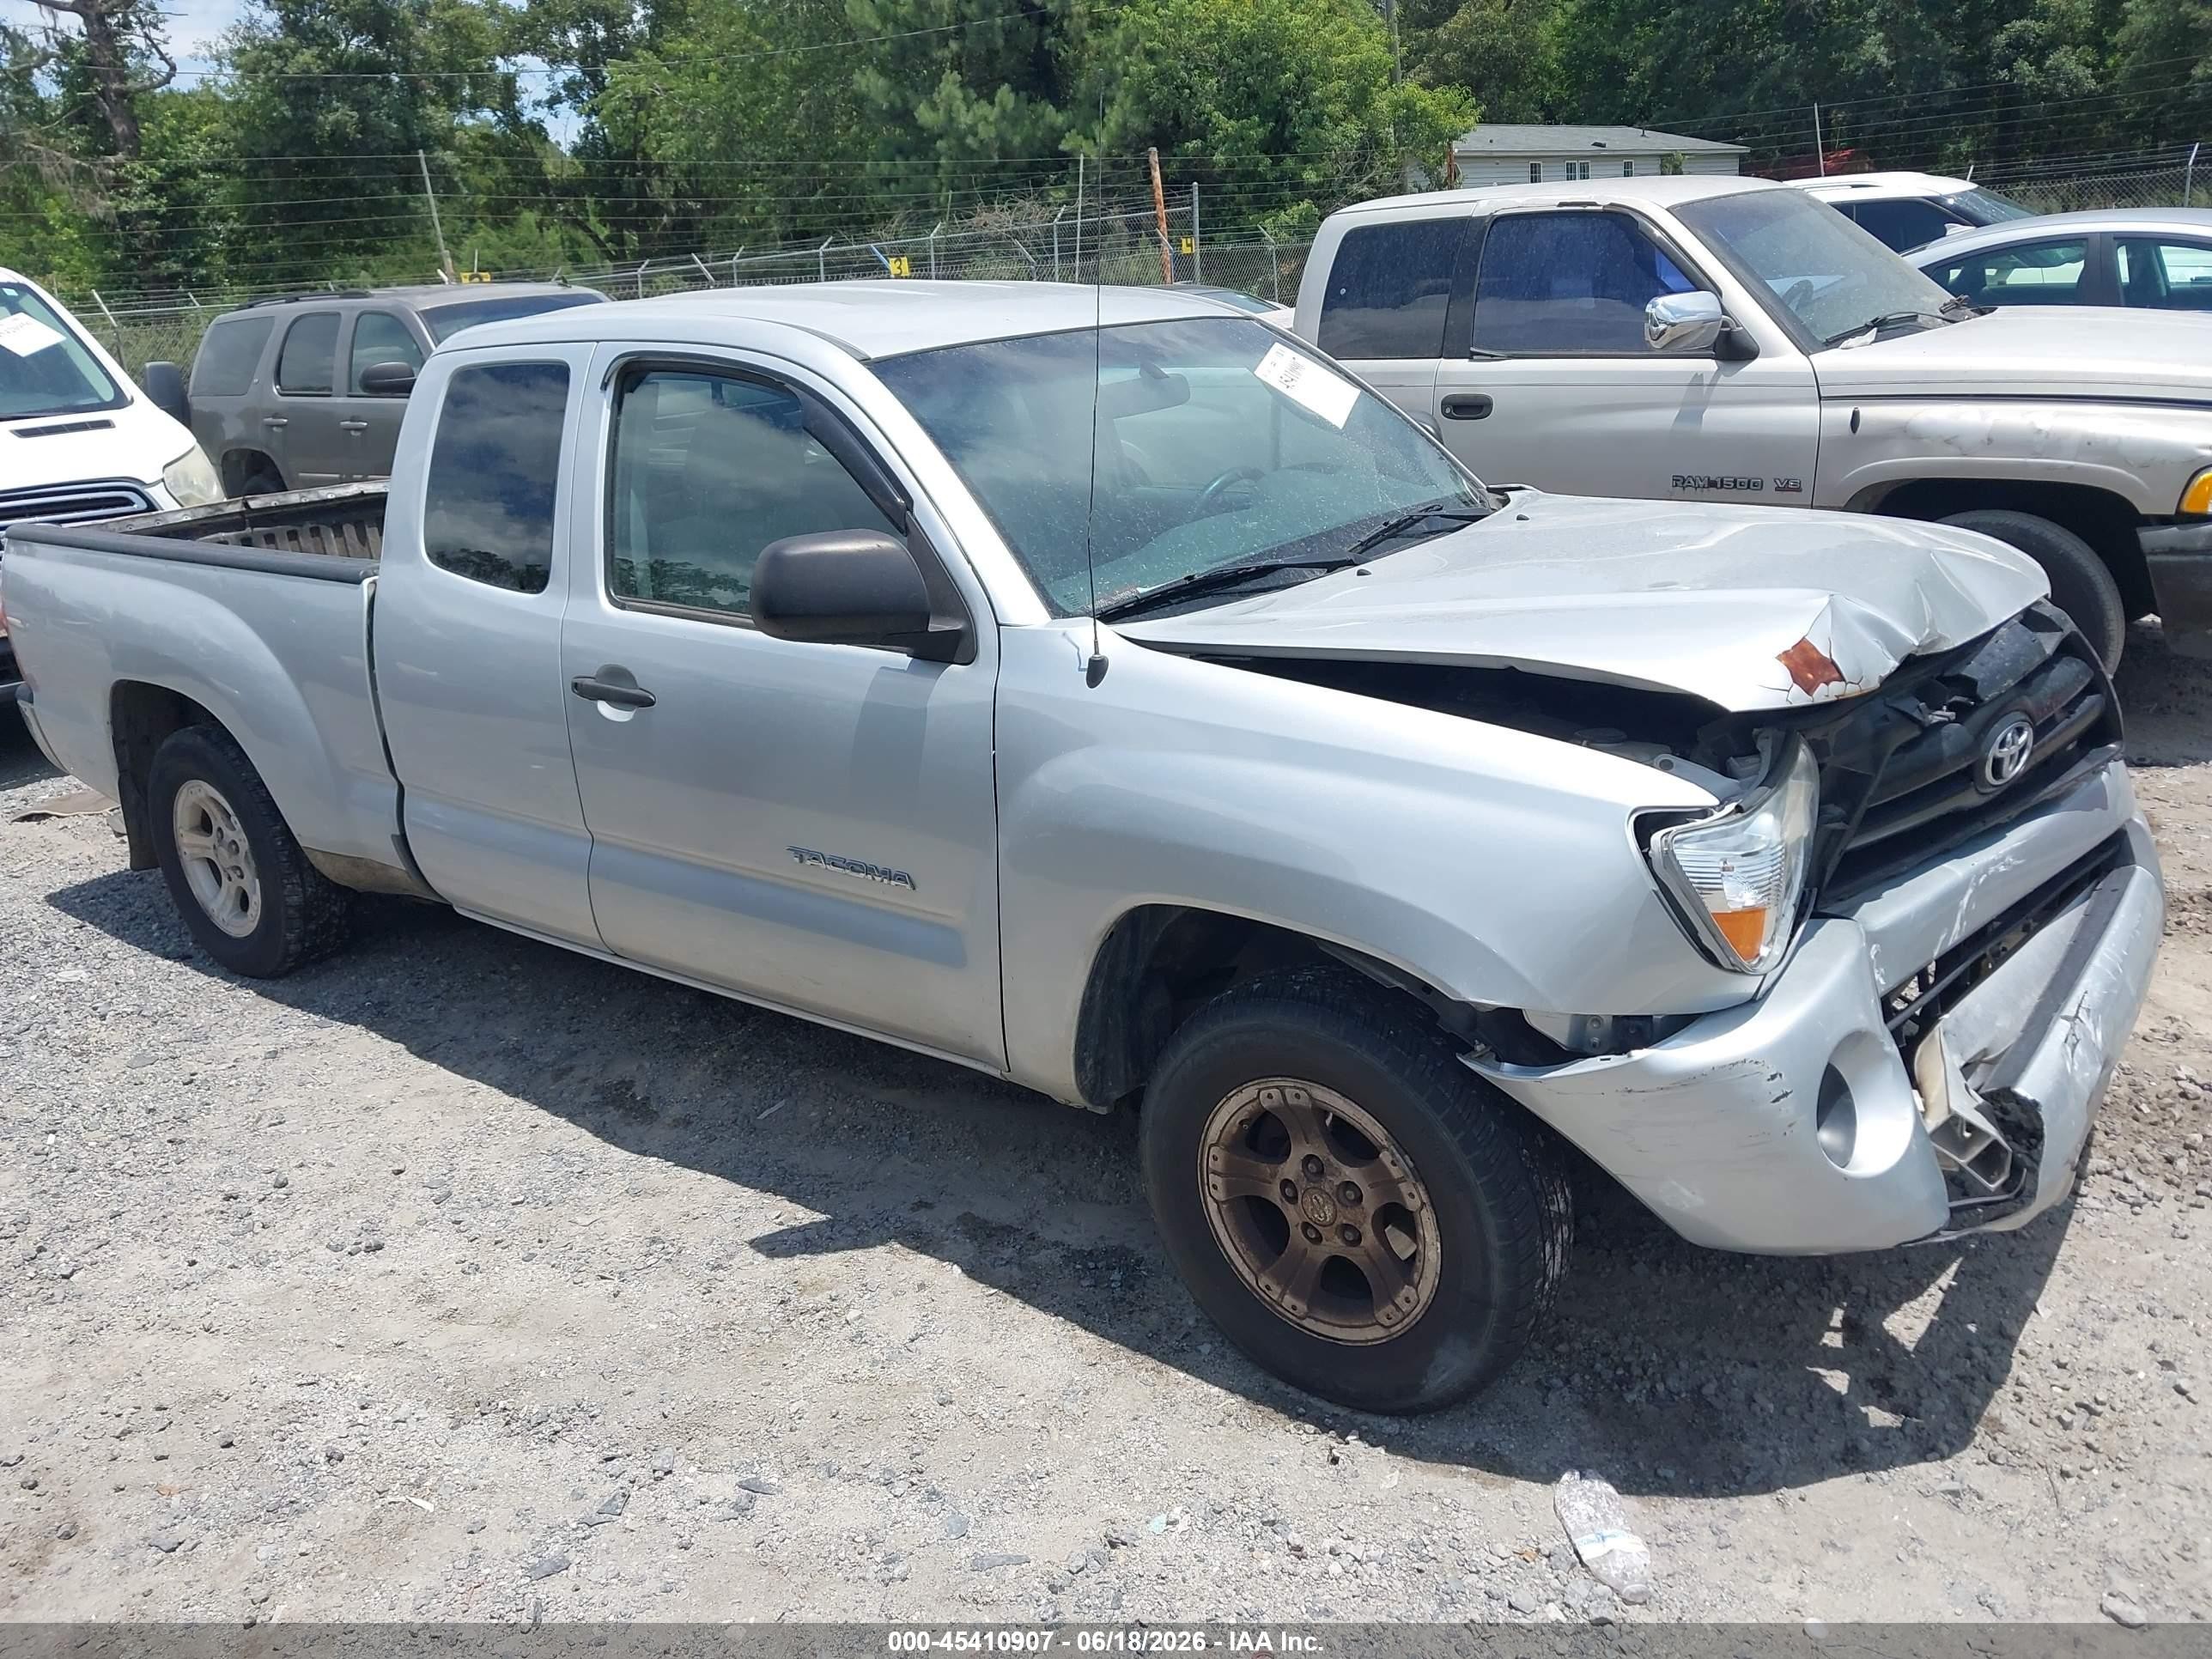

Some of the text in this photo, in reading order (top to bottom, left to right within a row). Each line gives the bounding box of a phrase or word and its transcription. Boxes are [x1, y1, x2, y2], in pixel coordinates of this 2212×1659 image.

[1185, 237, 1194, 253] 4
[893, 258, 903, 276] 3
[1672, 475, 1709, 489] RAM
[1717, 477, 1764, 490] 1500
[785, 845, 916, 890] TACOMA
